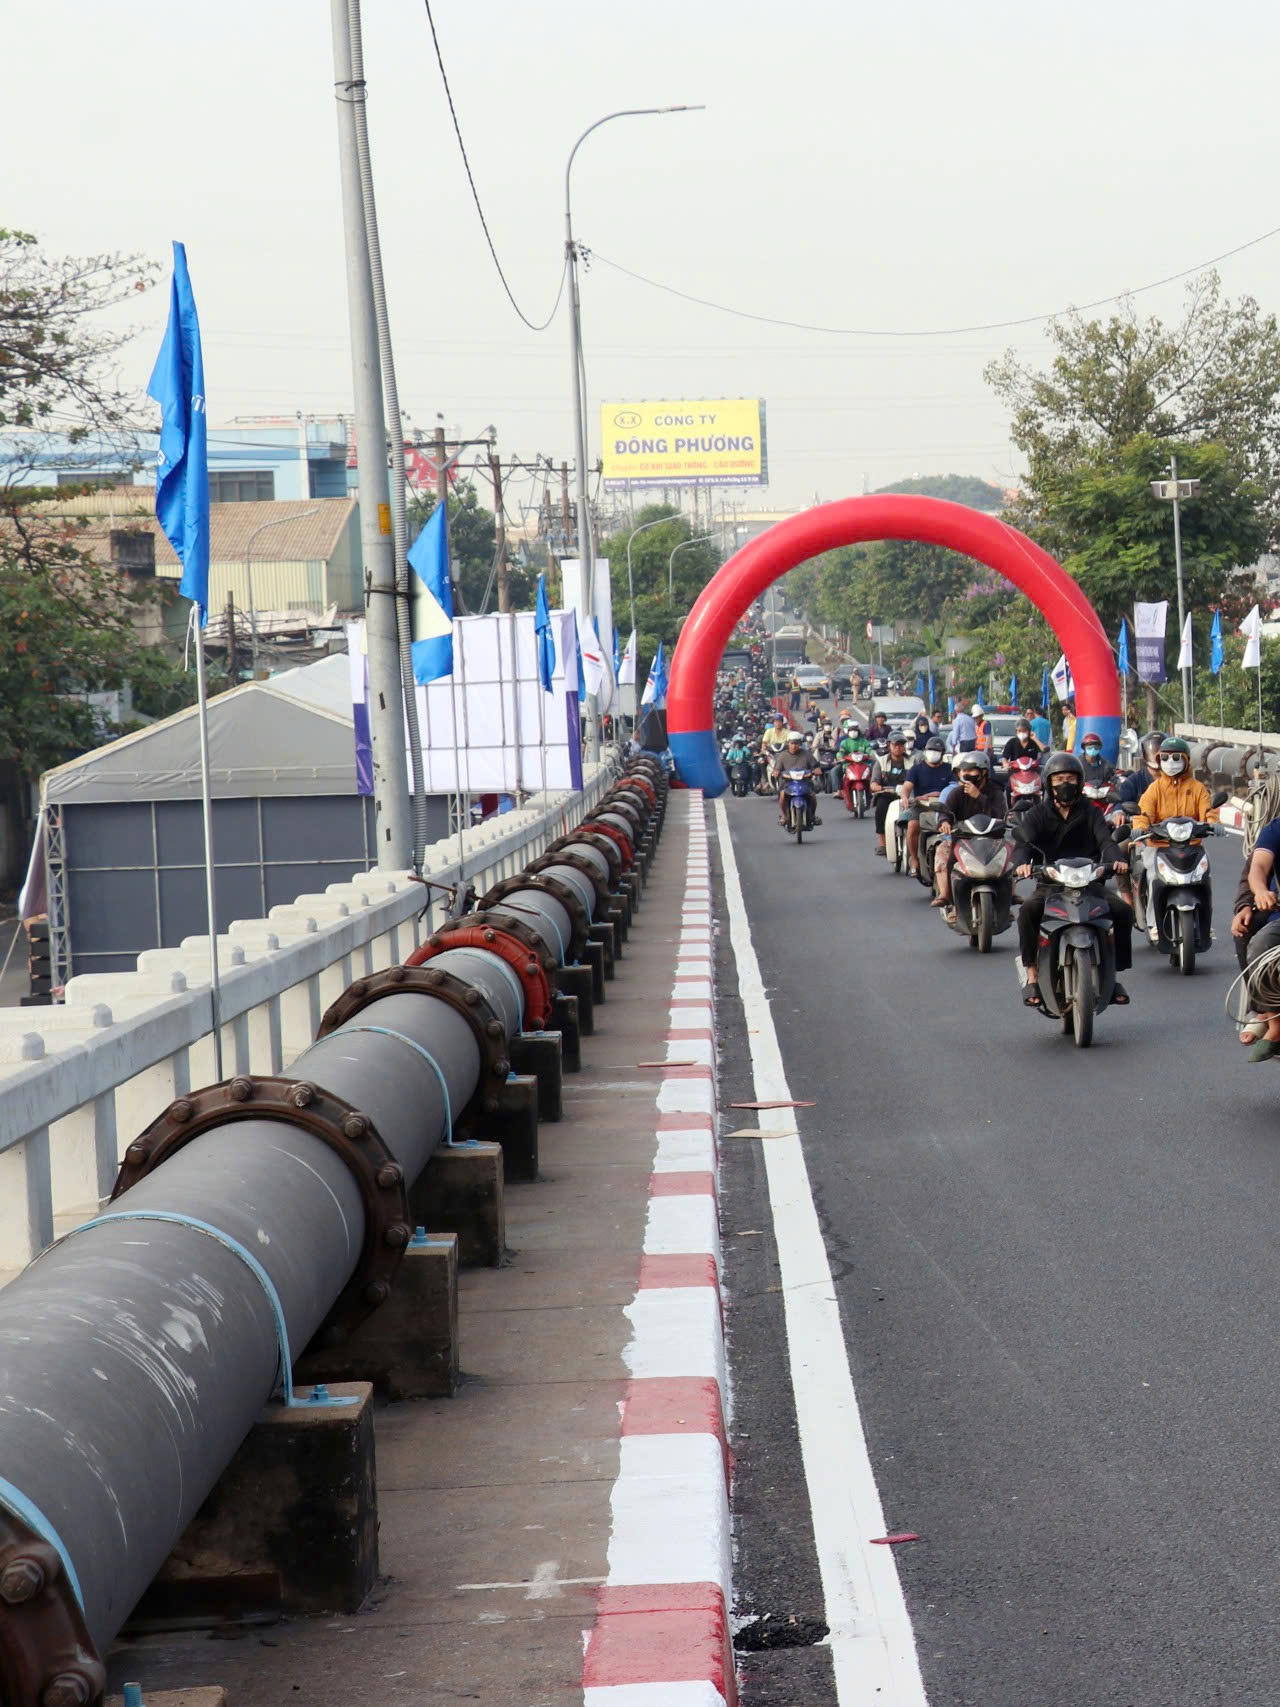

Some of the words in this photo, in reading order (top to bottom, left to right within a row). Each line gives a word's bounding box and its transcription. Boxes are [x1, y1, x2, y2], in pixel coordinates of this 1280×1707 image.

[699, 414, 717, 425] TY
[614, 436, 669, 454] ĐÔNG
[674, 434, 755, 452] PHƯƠNG
